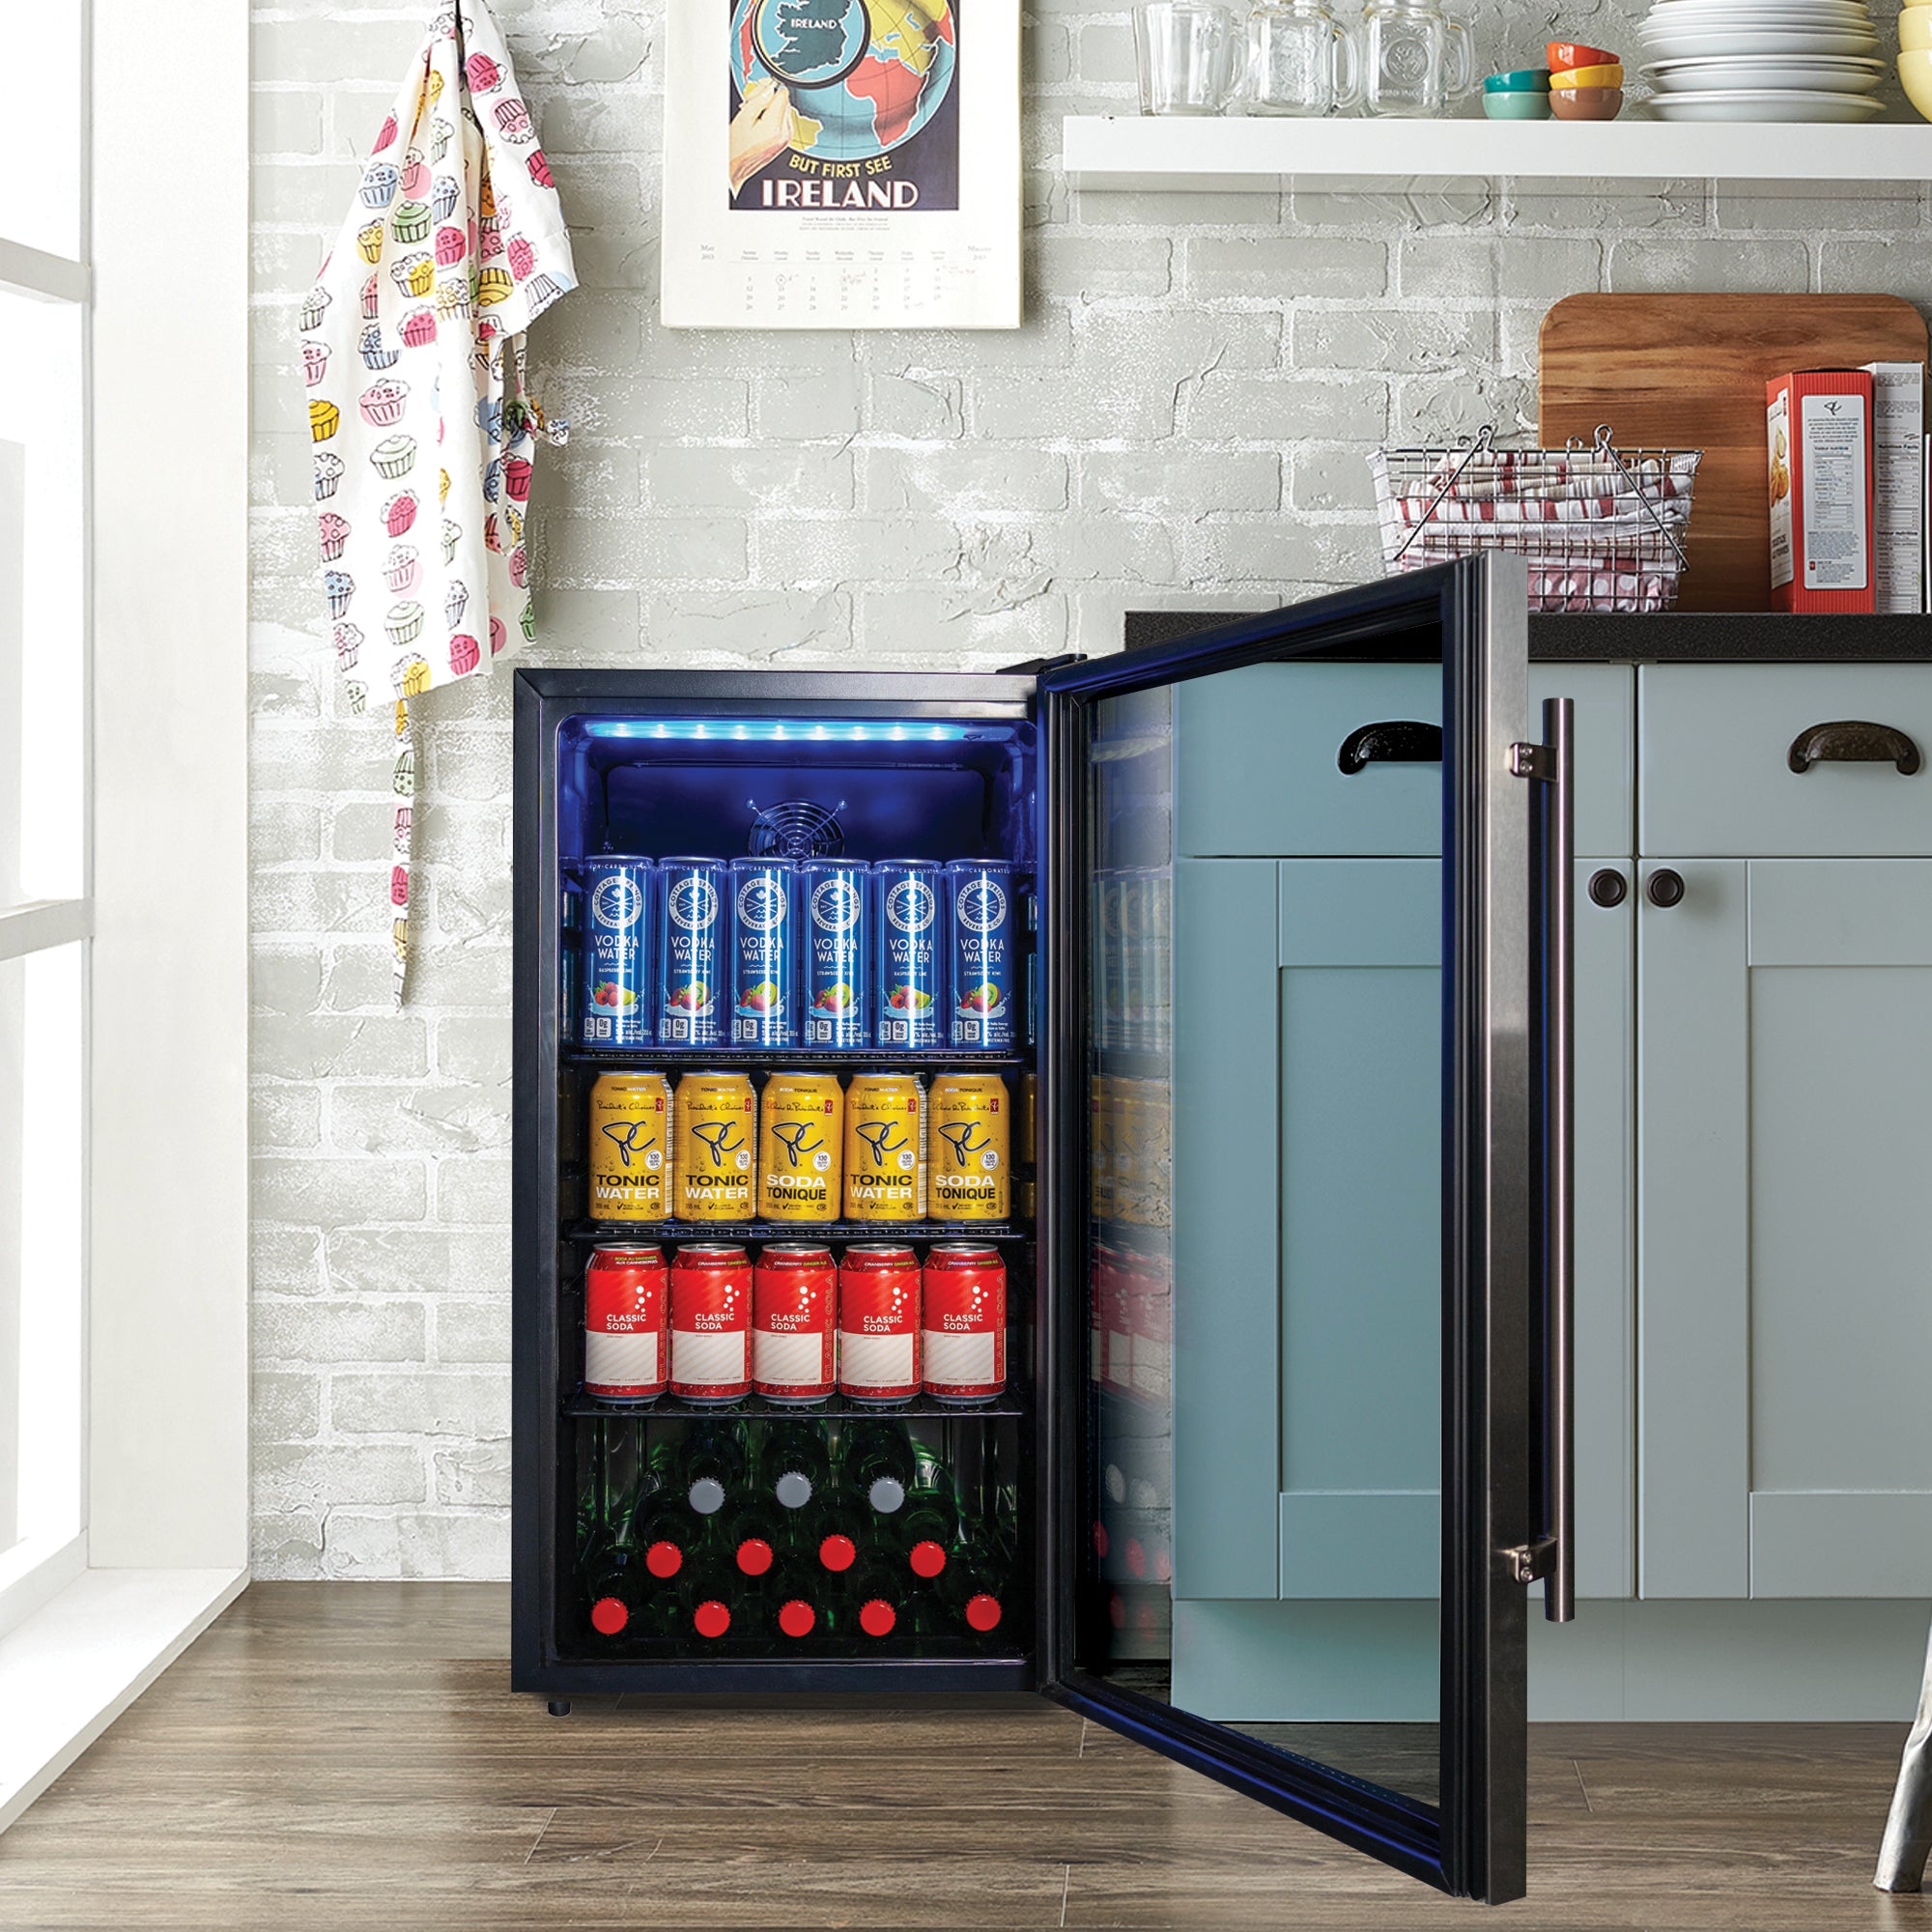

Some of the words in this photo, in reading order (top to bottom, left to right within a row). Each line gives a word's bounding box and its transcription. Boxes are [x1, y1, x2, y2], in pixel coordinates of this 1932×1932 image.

[790, 18, 838, 30] IRELAND
[788, 154, 819, 175] BUT
[821, 162, 861, 178] FIRST
[866, 156, 893, 176] SEE
[762, 180, 919, 209] IRELAND
[594, 879, 617, 906] COTTAGE
[739, 880, 761, 908] COTTAGE
[811, 883, 835, 910] COTTAGE
[957, 881, 982, 910] COTTAGE
[986, 882, 1006, 910] SPRINGS
[674, 916, 704, 929] BEVERAE
[743, 917, 770, 929] BEVERAG
[816, 918, 842, 931] BEVERA
[893, 918, 922, 932] BEVERE
[963, 918, 993, 931] BEVERAE
[595, 935, 639, 948] VODKA
[671, 936, 716, 950] VODKA
[740, 937, 784, 950] VODKA
[814, 938, 858, 951] VODKA
[890, 939, 933, 951] VODKA
[960, 939, 1005, 951] VODKA
[598, 949, 636, 960] WATER
[743, 950, 781, 961] WATER
[817, 952, 854, 963] WATER
[596, 1175, 660, 1186] TONIC
[686, 1175, 749, 1186] TONIC
[766, 1175, 827, 1187] SODA
[851, 1175, 913, 1186] TONIC
[936, 1175, 995, 1187] SODA
[596, 1187, 660, 1200] WATER
[685, 1187, 749, 1200] WATER
[766, 1187, 827, 1201] TONIQUE
[850, 1187, 913, 1199] WATER
[936, 1187, 996, 1200] TONIQUE
[825, 1273, 834, 1316] COLA
[607, 1314, 647, 1322] CLASSIC
[696, 1313, 735, 1321] CLASSIC
[771, 1314, 810, 1322] CLASSIC
[864, 1316, 903, 1324] CLASSIC
[943, 1314, 983, 1322] CLASSIC
[607, 1322, 634, 1331] SODA
[696, 1321, 723, 1330] SODA
[771, 1322, 798, 1331] SODA
[864, 1323, 891, 1332] SODA
[825, 1319, 834, 1379] CLASSIC
